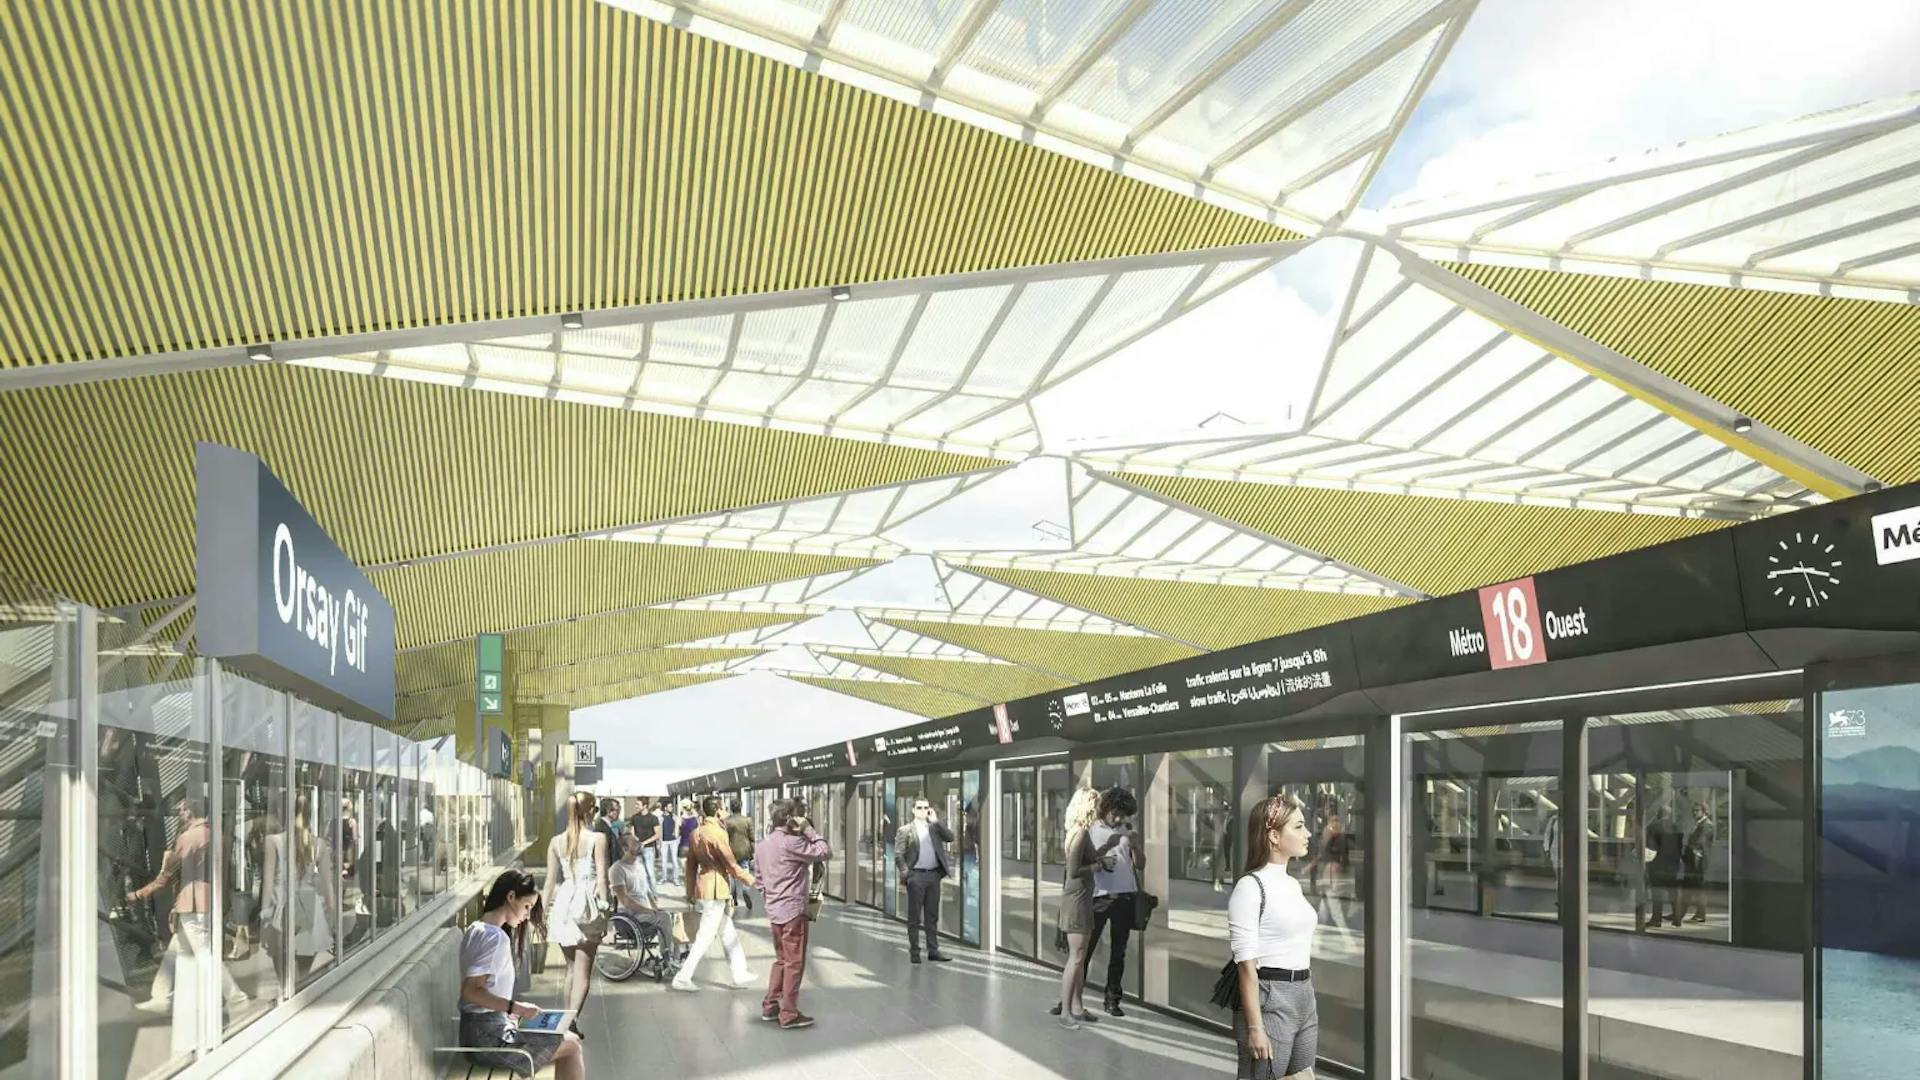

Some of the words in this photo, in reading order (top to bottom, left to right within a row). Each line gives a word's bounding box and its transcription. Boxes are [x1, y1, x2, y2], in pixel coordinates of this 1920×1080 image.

[273, 522, 340, 677] Orsay
[343, 589, 369, 674] Gif
[1449, 627, 1485, 657] Métro
[1492, 586, 1534, 662] 18
[1545, 606, 1589, 640] Ouest
[1186, 673, 1206, 688] trafic
[1229, 668, 1243, 680] sur
[1242, 664, 1252, 677] la
[1251, 662, 1273, 677] ligne
[1272, 658, 1280, 671] 7
[1279, 650, 1313, 673] jusqu'à
[1312, 648, 1328, 663] 8h
[1189, 695, 1207, 708] slow
